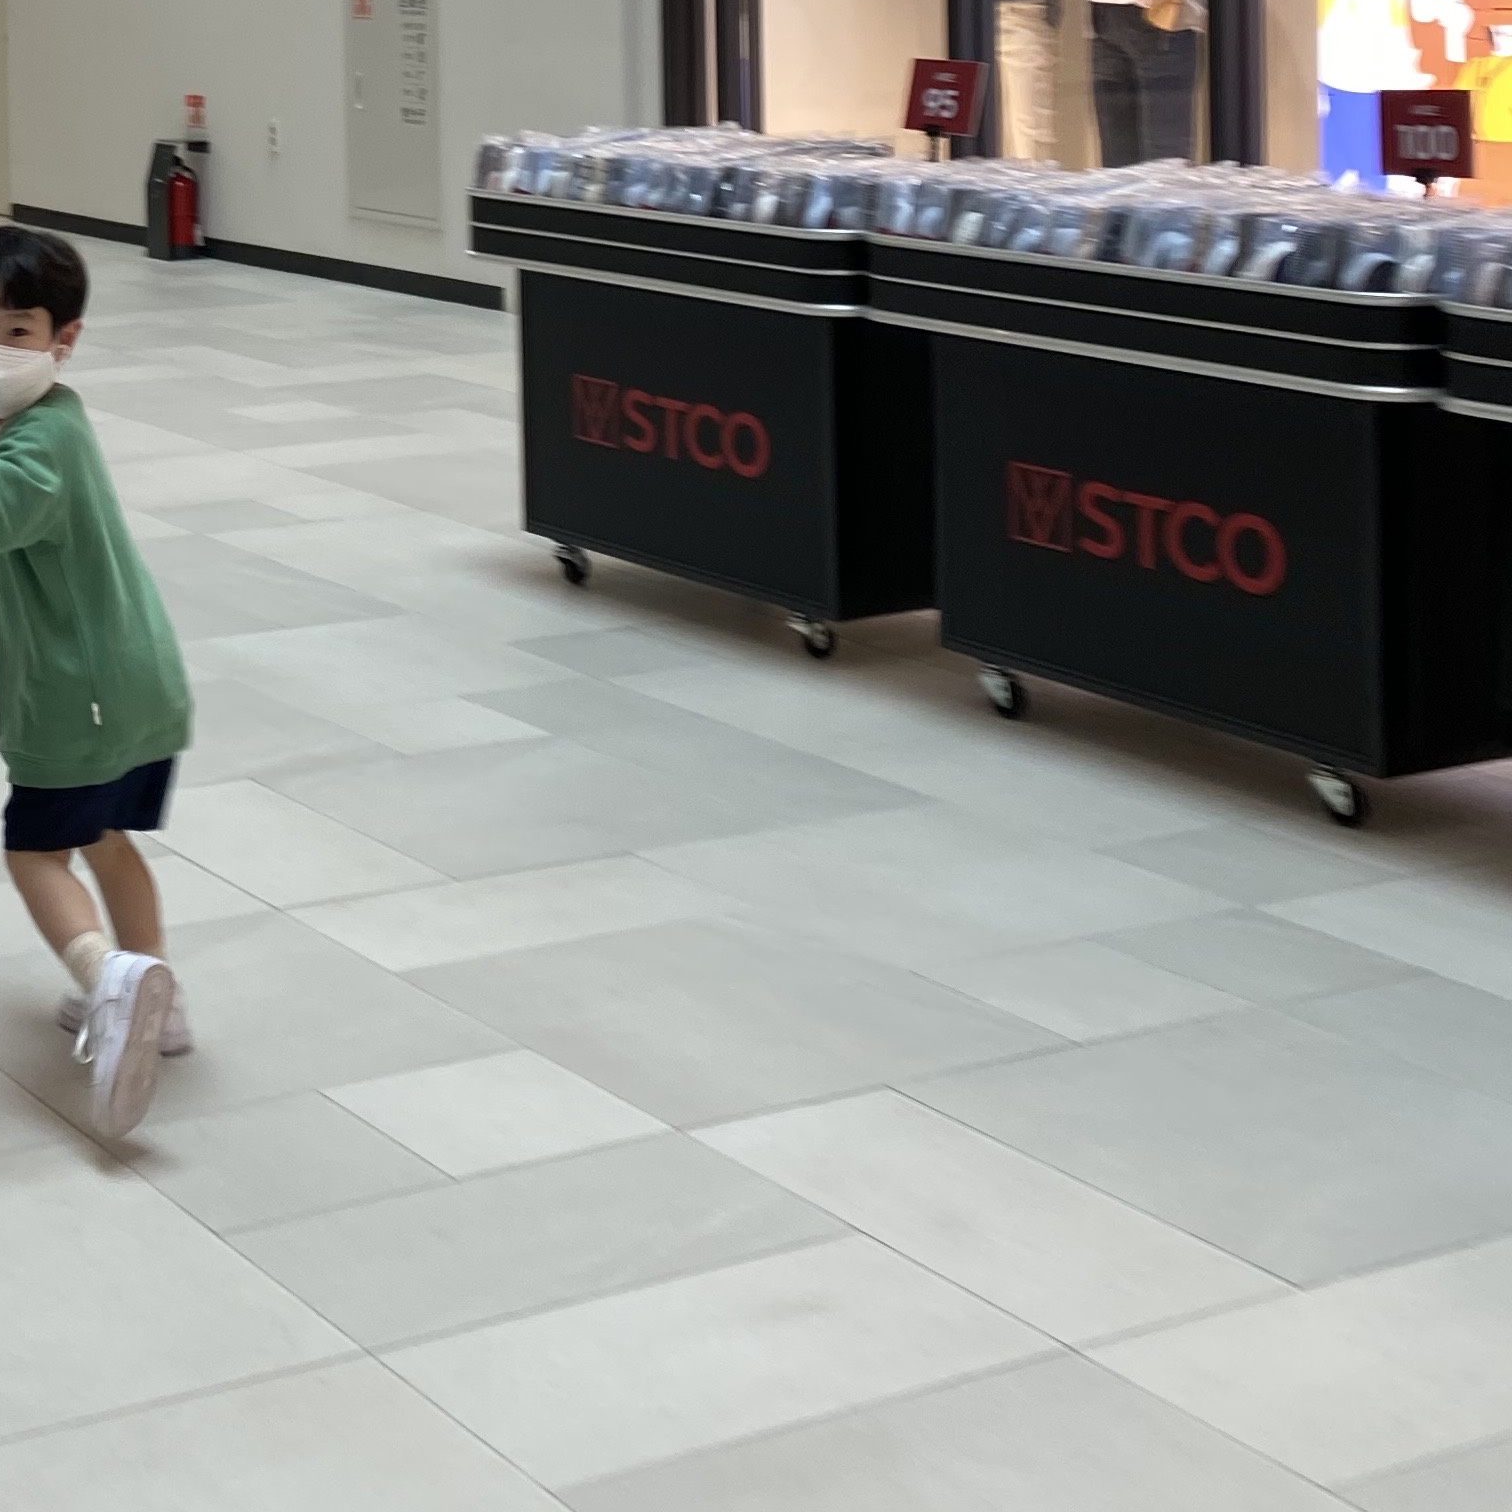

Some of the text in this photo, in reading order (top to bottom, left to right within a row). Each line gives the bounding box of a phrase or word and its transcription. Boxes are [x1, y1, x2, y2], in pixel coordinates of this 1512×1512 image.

[922, 88, 960, 119] 95
[1393, 124, 1459, 161] 100
[623, 389, 771, 478] STCO
[1078, 480, 1286, 596] STCO
